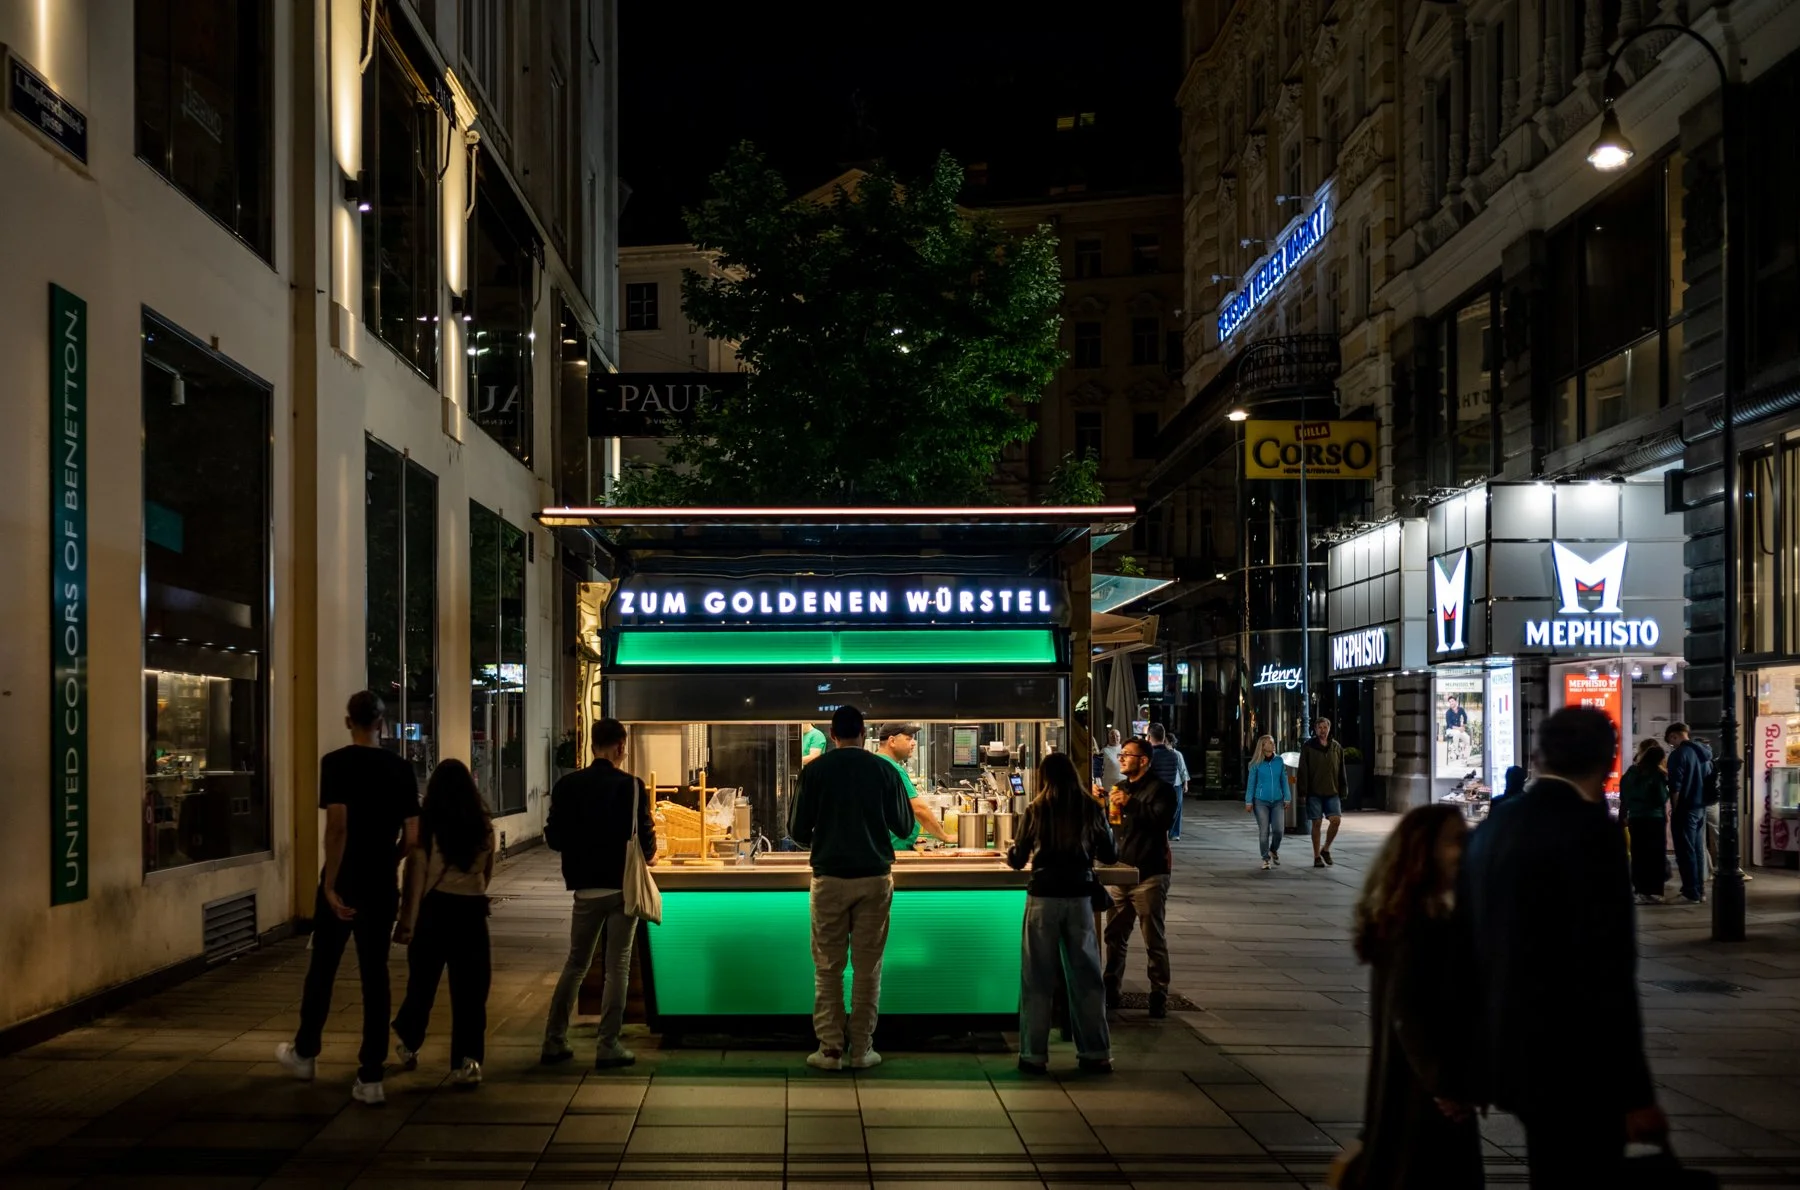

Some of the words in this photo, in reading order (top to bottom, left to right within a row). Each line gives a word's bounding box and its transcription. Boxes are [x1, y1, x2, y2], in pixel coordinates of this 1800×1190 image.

[1253, 246, 1288, 303] NEUER
[1286, 202, 1327, 268] MARKT
[64, 520, 79, 572] OF
[619, 591, 687, 615] ZUM
[704, 591, 889, 615] GOLDENEN
[906, 587, 1052, 614] WÜRSTEL
[1332, 628, 1385, 671] MEPHISTO
[1526, 618, 1660, 647] MEPHISTO
[64, 583, 80, 736] COLORS
[1258, 663, 1303, 690] Henry
[1569, 679, 1608, 688] MEPHISTO
[64, 749, 80, 888] UNITED
